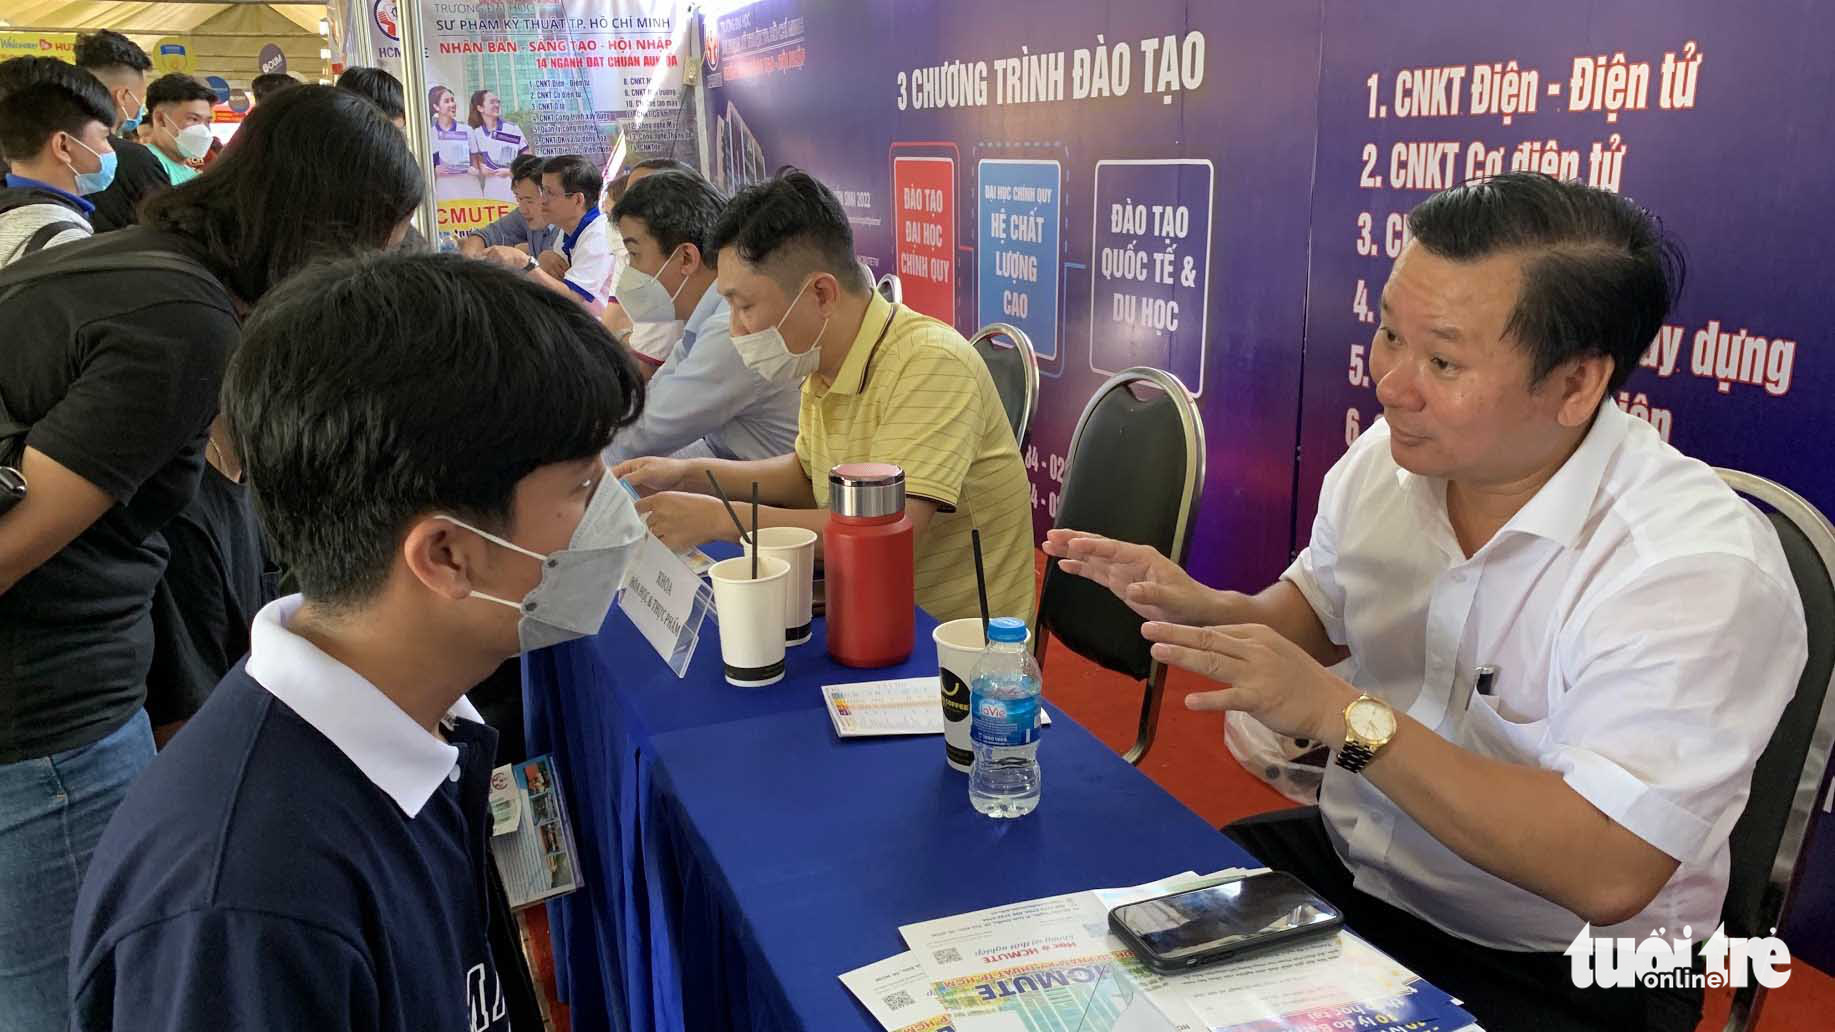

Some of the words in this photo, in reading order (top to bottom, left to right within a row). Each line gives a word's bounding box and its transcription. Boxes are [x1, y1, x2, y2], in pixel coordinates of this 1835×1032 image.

[459, 20, 499, 33] PHẠM
[635, 17, 671, 29] MINH
[896, 71, 908, 111] 3
[911, 60, 988, 110] CHƯƠNG
[993, 45, 1065, 105] TRÌNH
[1072, 33, 1131, 100] ĐÀO
[1140, 30, 1206, 105] TẠO
[1367, 73, 1388, 119] 1.
[1394, 66, 1465, 118] CNKT
[1470, 60, 1539, 126] Điện
[1547, 83, 1561, 95] -
[1568, 51, 1650, 123] Điện
[1659, 41, 1703, 110] tử
[1360, 143, 1382, 189] 2.
[1389, 142, 1460, 190] CNKT
[903, 184, 924, 211] ĐÀO
[923, 188, 944, 217] TẠO
[904, 221, 921, 250] ĐẠI
[921, 222, 943, 252] HỌC
[991, 208, 1008, 245] HỆ
[1010, 206, 1045, 244] CHẤT
[1110, 197, 1147, 236] ĐÀO
[1151, 204, 1190, 245] TẠO
[1356, 212, 1379, 257] 3.
[900, 250, 929, 279] CHÍNH
[930, 259, 950, 283] QUY
[995, 250, 1038, 285] LƯỢNG
[1101, 240, 1148, 282] QUỐC
[1152, 242, 1178, 285] TẾ
[1180, 256, 1197, 288] &
[1003, 290, 1029, 320] CAO
[1134, 296, 1179, 336] HỌC
[1352, 280, 1375, 323] 4.
[1691, 319, 1797, 396] dựng
[1348, 344, 1370, 388] 5.
[655, 570, 673, 597] KHOA
